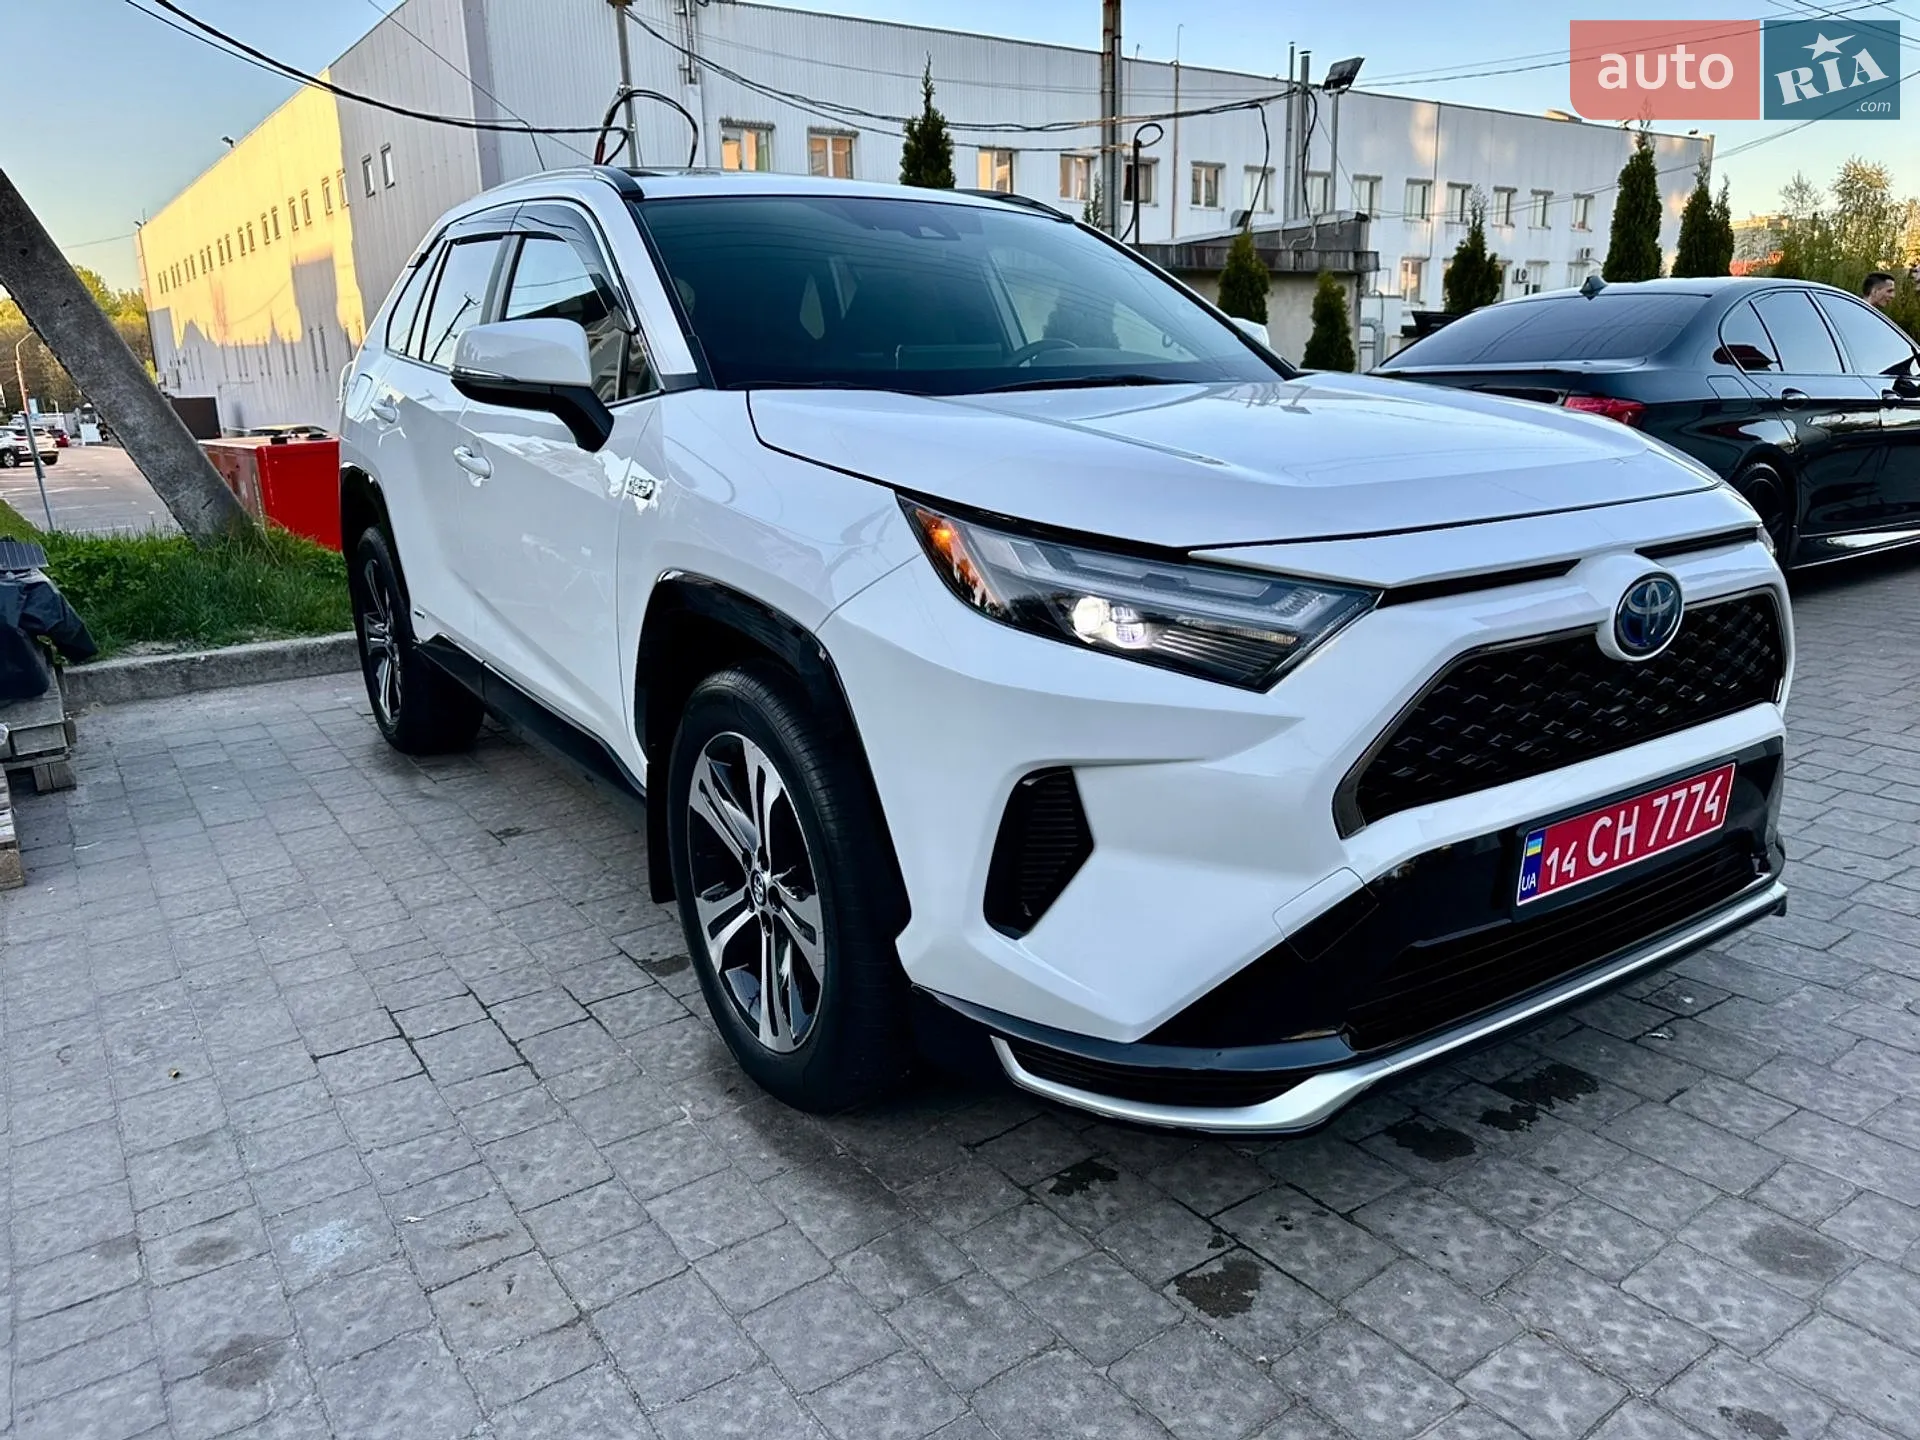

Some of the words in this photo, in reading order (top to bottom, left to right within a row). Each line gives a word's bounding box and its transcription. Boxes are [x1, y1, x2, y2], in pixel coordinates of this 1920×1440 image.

[1546, 841, 1578, 885] 14
[1587, 805, 1640, 867] CH
[1648, 774, 1724, 847] 7774
[1521, 872, 1537, 891] UA
